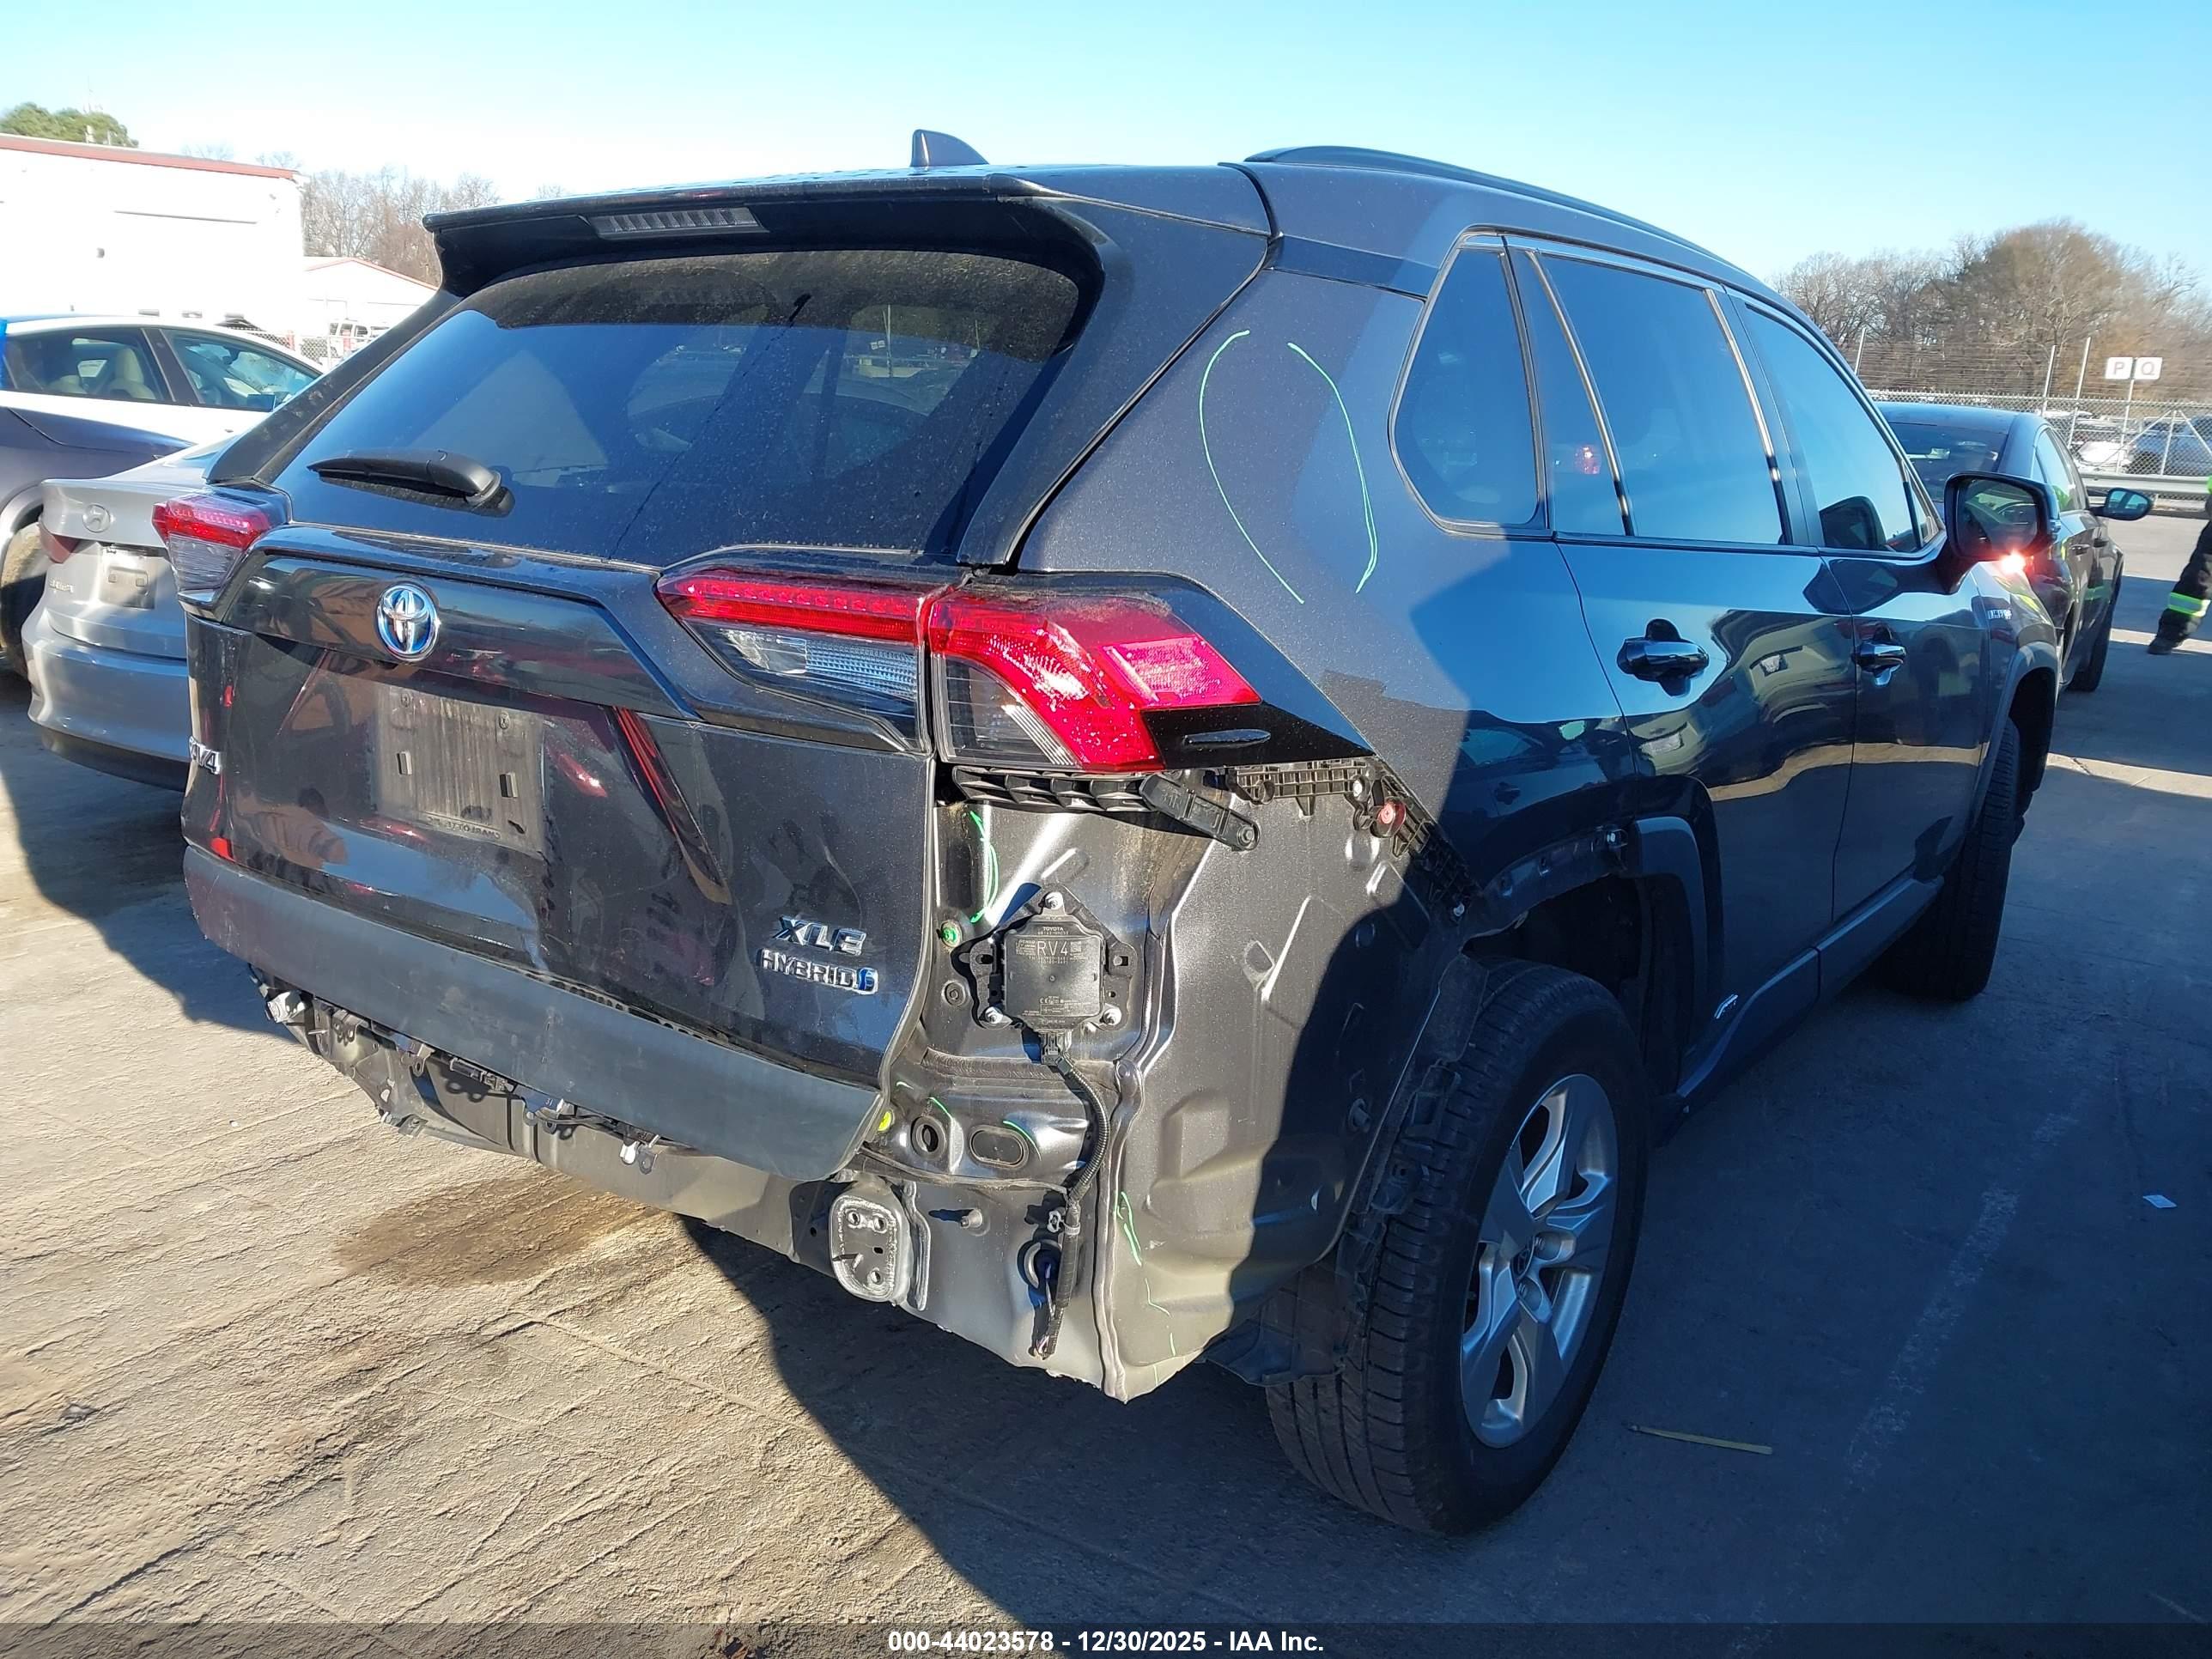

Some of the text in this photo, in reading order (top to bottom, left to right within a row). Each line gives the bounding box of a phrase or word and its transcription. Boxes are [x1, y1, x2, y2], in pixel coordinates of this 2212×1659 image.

[2113, 362, 2125, 375] P
[2142, 362, 2155, 376] Q
[772, 915, 867, 957] XLE
[1037, 940, 1068, 957] RV4
[756, 947, 858, 992] HYBRID
